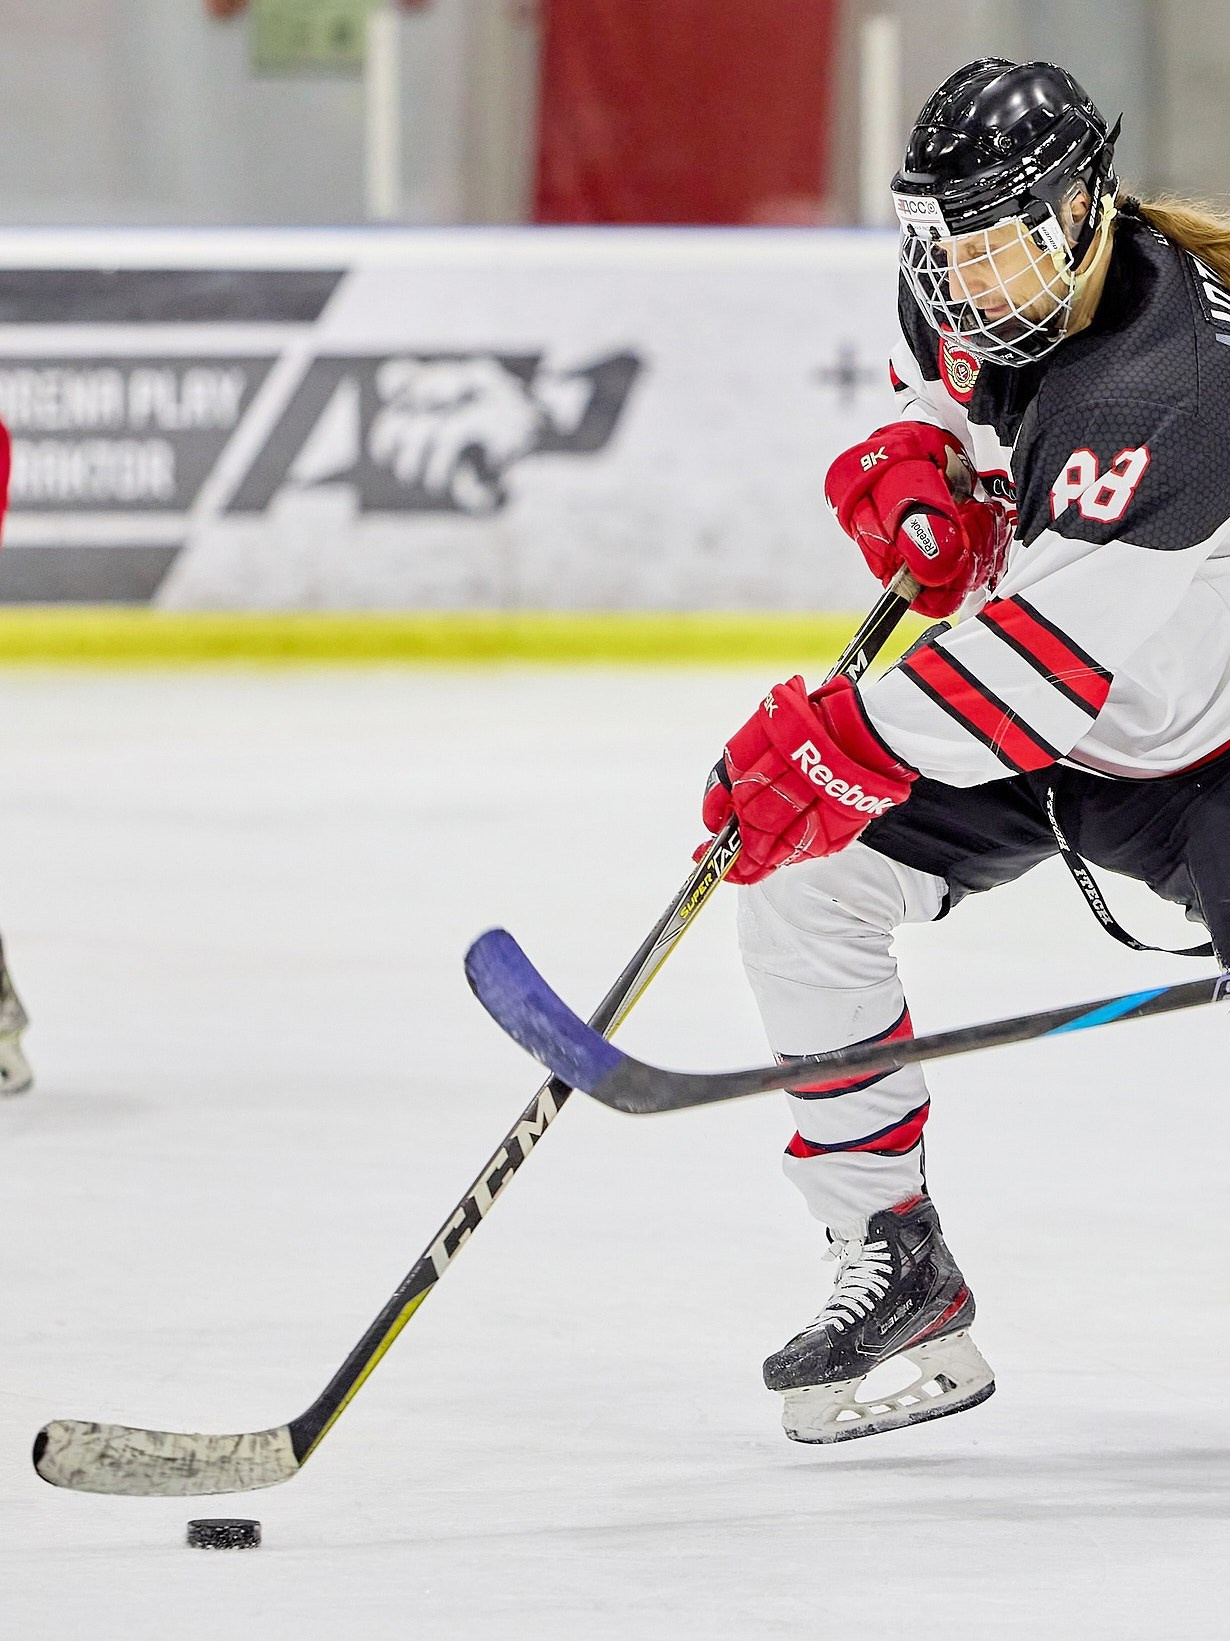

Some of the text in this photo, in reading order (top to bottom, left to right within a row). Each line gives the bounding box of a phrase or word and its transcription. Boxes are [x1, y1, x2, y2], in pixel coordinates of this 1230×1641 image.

[860, 446, 889, 472] 9K
[1048, 445, 1151, 524] 88
[910, 518, 938, 557] Reebok
[791, 740, 896, 815] Reebok
[680, 830, 742, 919] SUPER TAC
[1073, 868, 1114, 926] ITECH
[422, 1086, 559, 1279] CCM
